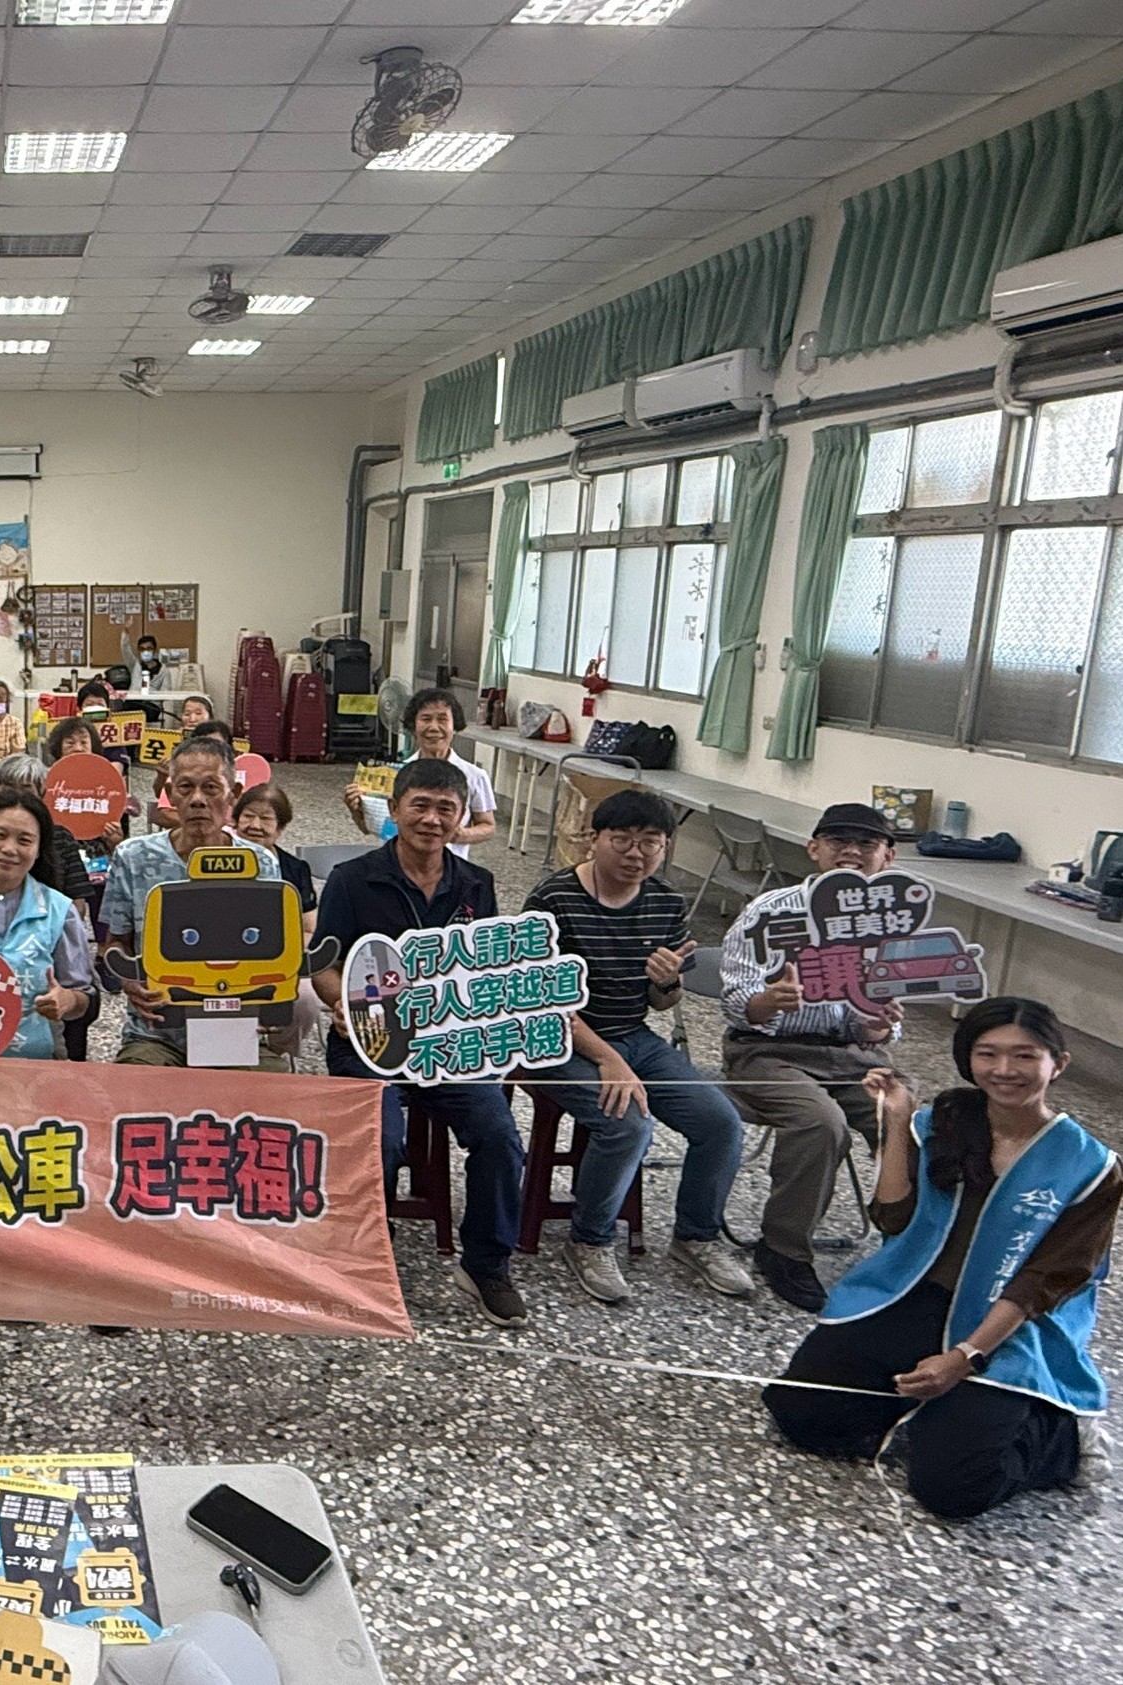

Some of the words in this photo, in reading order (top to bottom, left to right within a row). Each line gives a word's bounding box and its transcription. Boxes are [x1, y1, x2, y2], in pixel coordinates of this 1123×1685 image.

[99, 721, 143, 744] 免費
[205, 857, 241, 871] TAXI
[836, 884, 897, 912] 世界
[825, 909, 915, 940] 更美好
[401, 917, 552, 979] 行人請走
[395, 962, 582, 1030] 行人穿越道
[408, 1014, 564, 1078] 不滑手機
[91, 1504, 127, 1519] 全程
[15, 1533, 52, 1551] 全程
[85, 1567, 133, 1589] 黃24
[115, 1620, 142, 1629] TAXI
